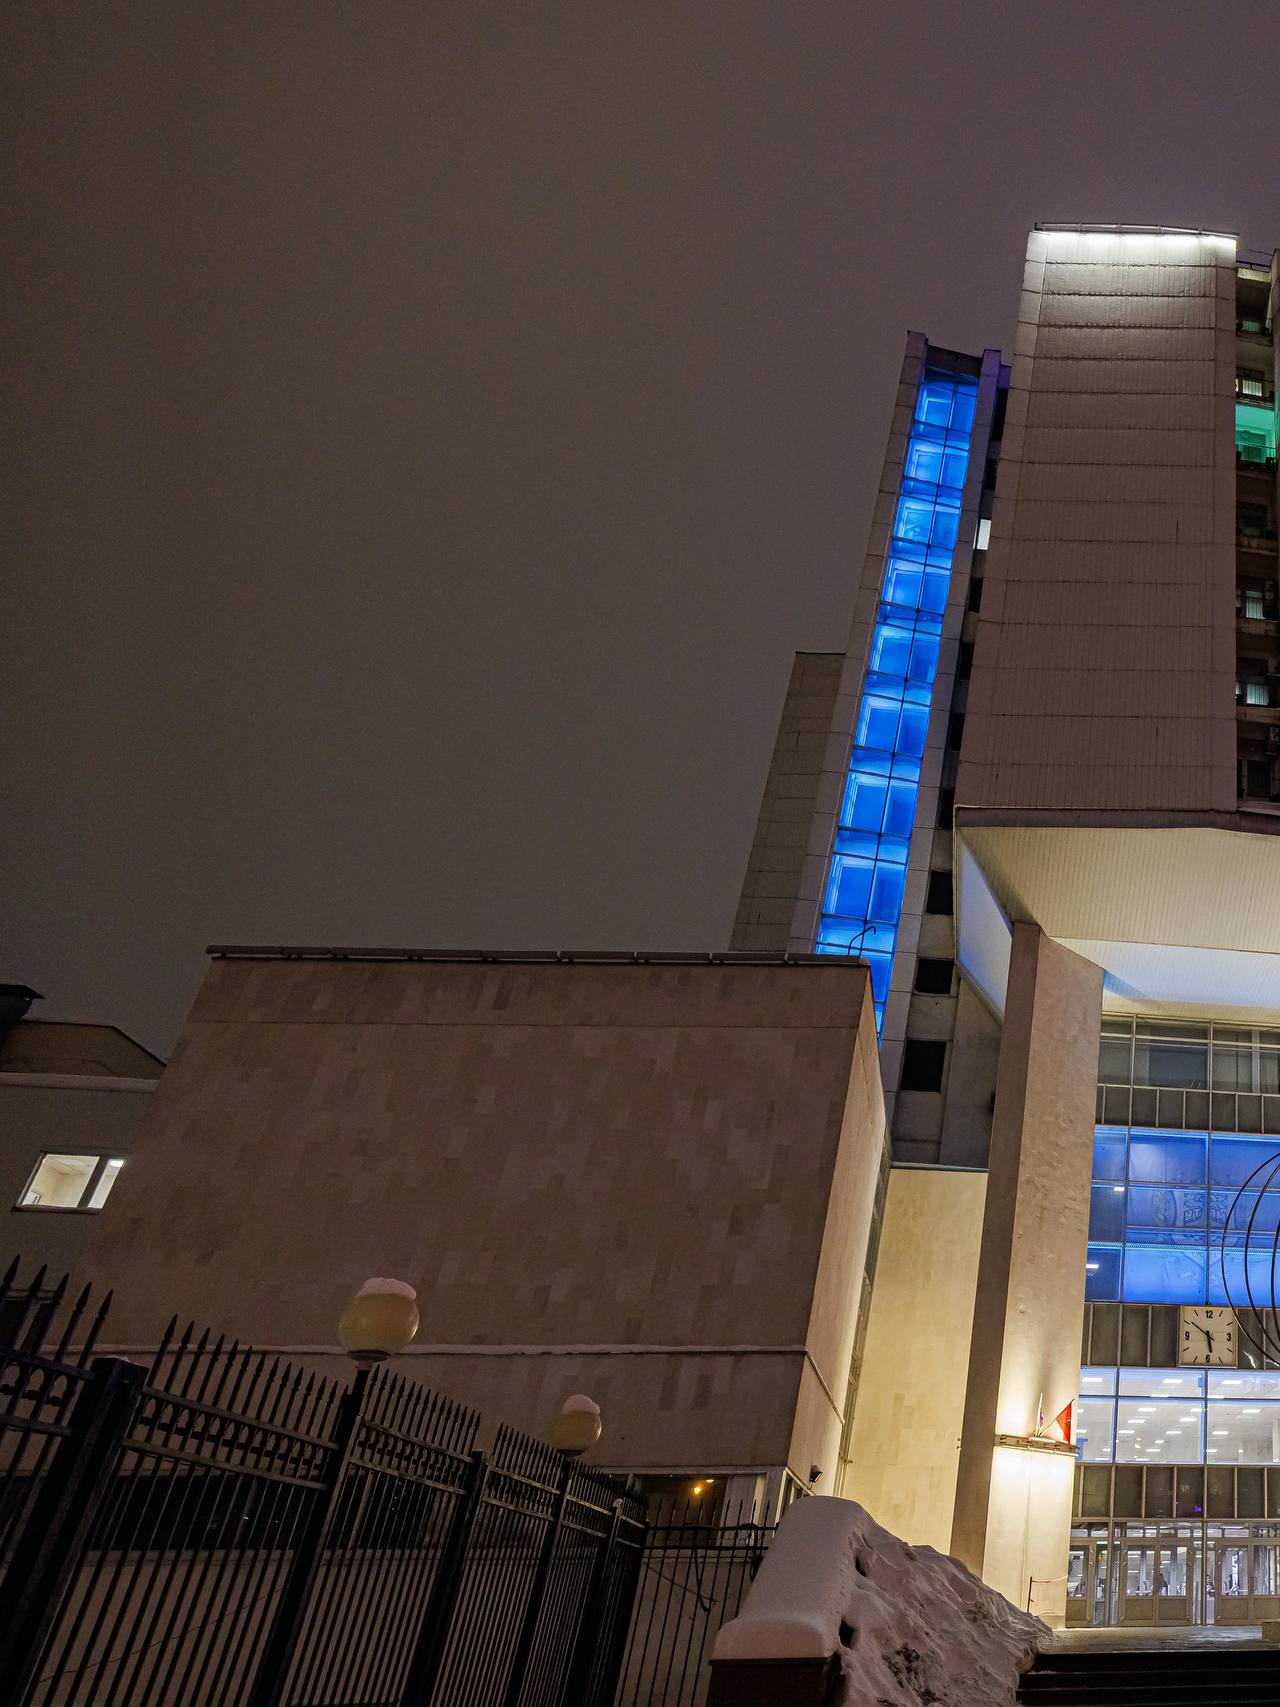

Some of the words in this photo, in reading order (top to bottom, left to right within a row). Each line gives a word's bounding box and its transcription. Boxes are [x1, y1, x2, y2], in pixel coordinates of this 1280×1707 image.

[1205, 1310, 1213, 1318] 12
[1184, 1331, 1190, 1340] 9
[1226, 1332, 1231, 1341] 3
[1205, 1354, 1210, 1363] 6
